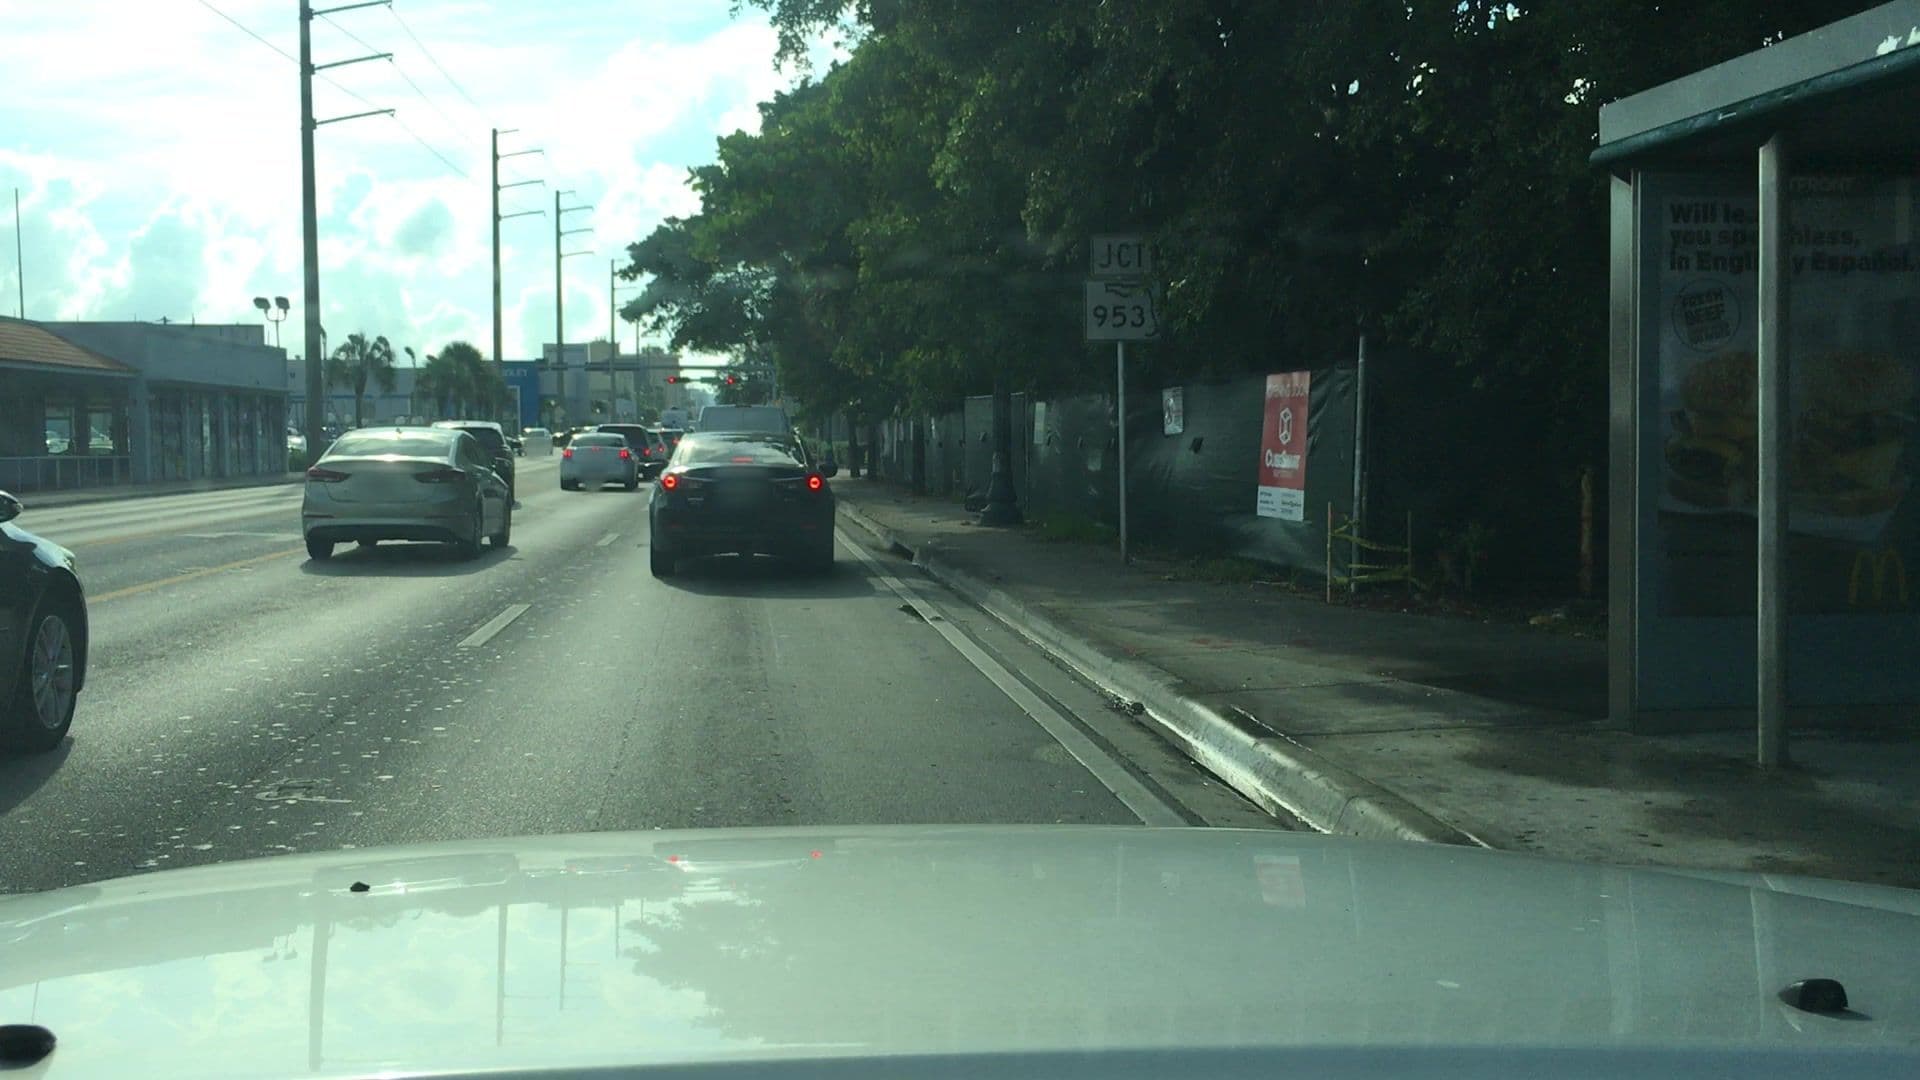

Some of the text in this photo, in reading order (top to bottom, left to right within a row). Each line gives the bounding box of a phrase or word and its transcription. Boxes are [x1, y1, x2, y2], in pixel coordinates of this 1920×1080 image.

[1670, 200, 1717, 224] Will
[1670, 229, 1711, 248] you
[1098, 243, 1146, 268] JCT
[1093, 305, 1146, 328] 953
